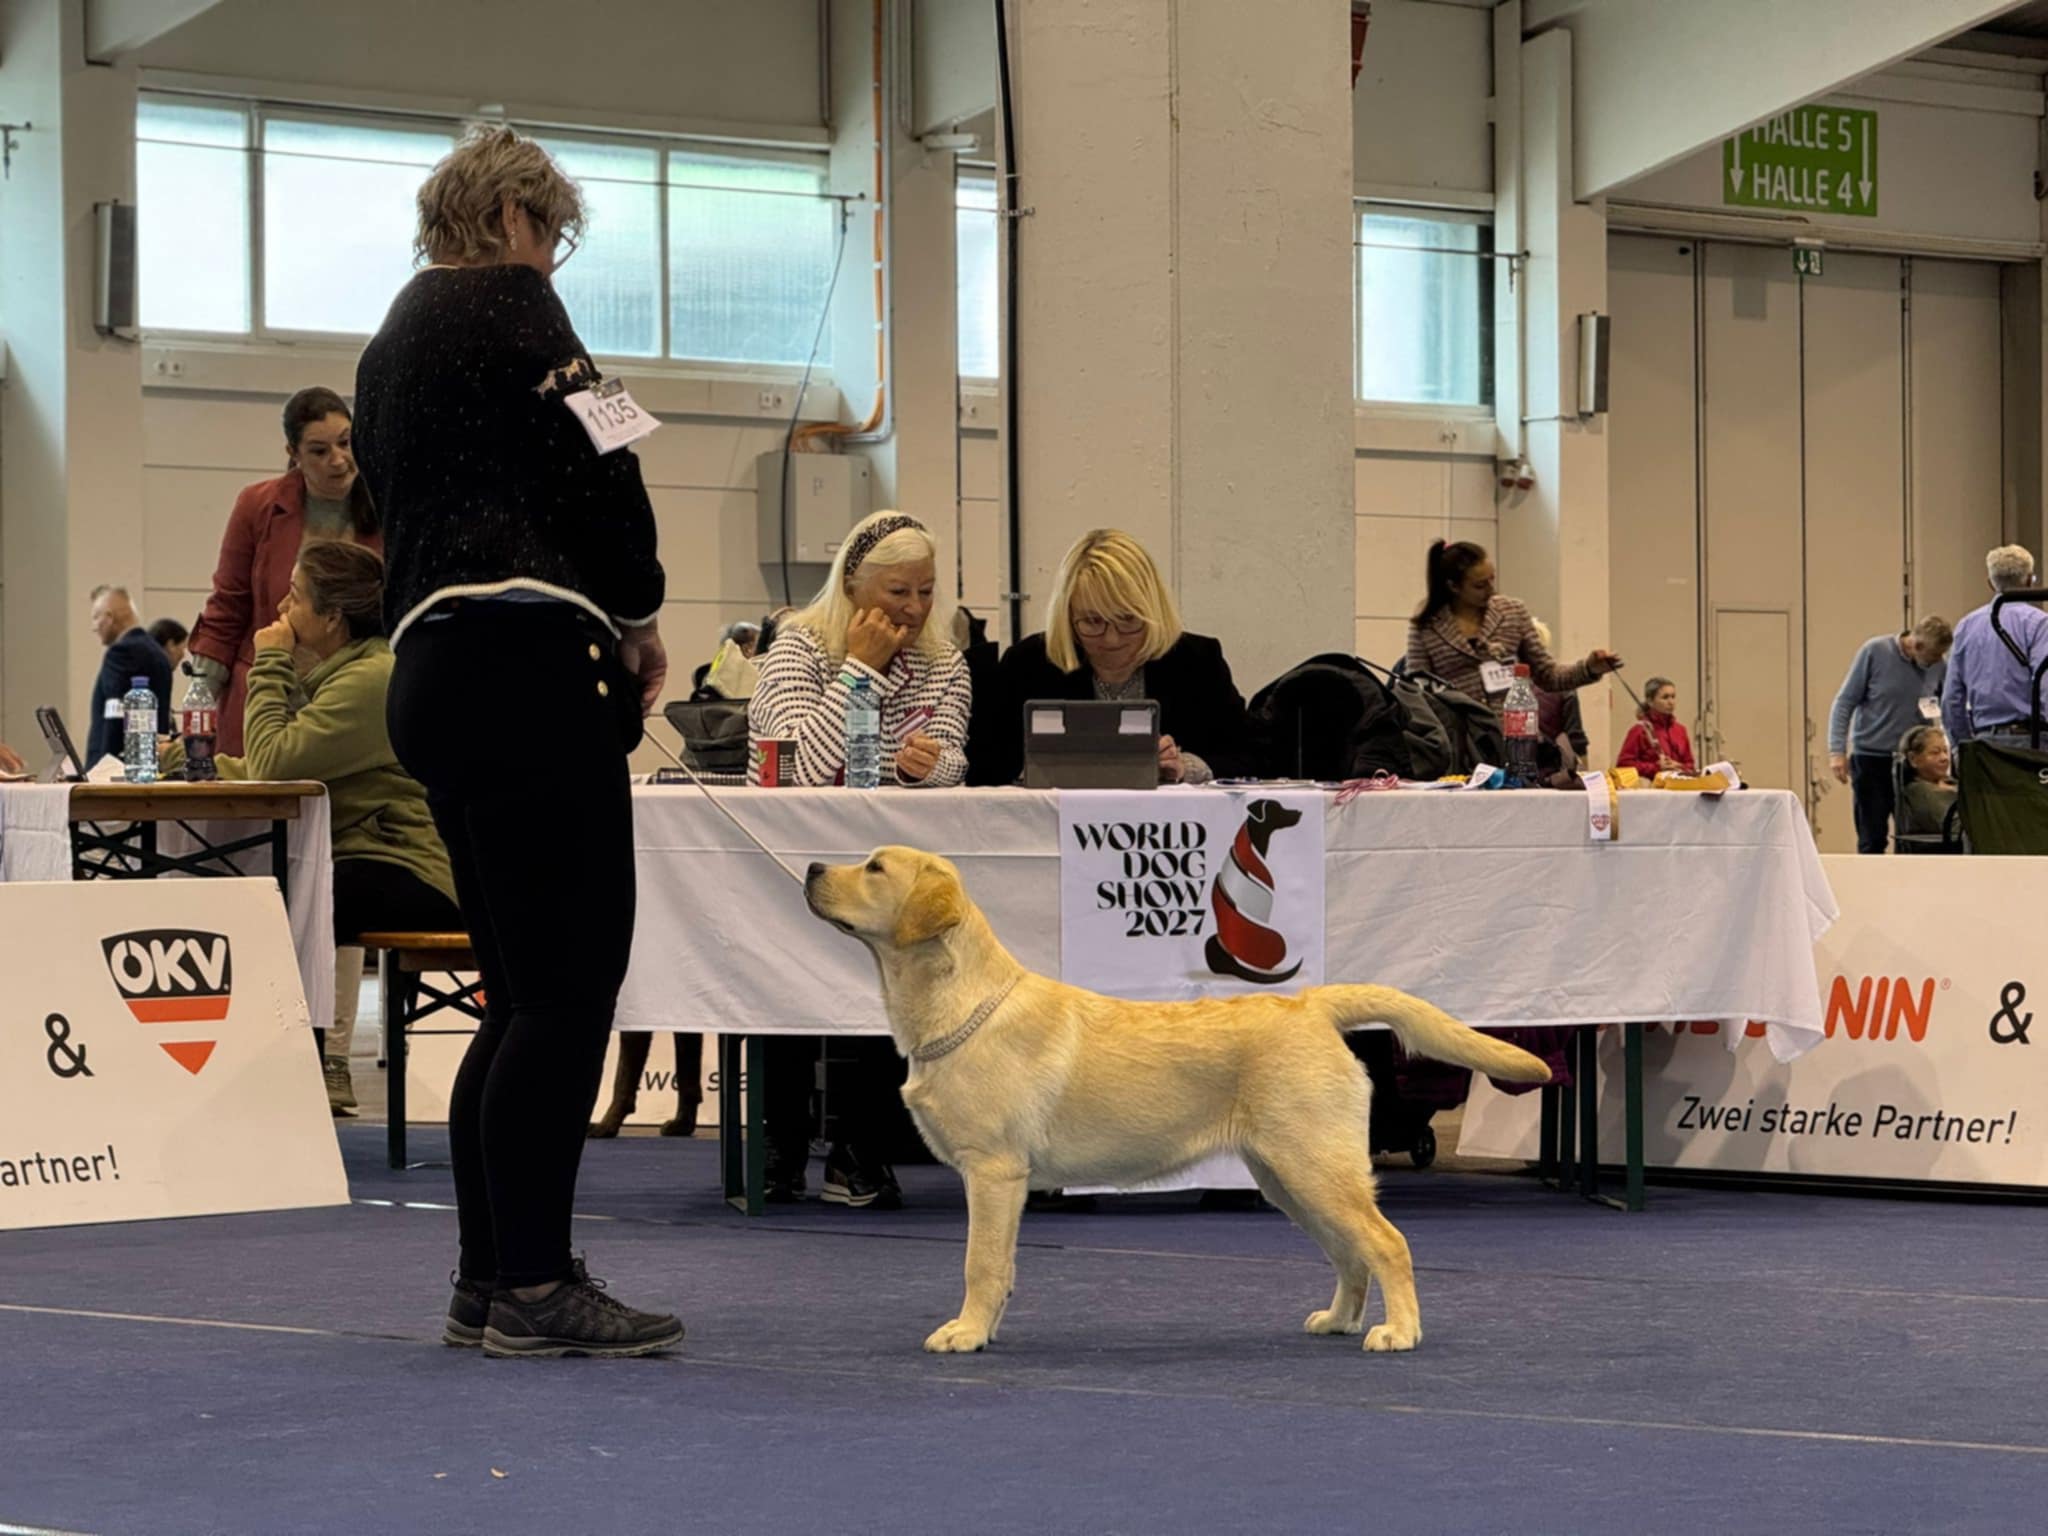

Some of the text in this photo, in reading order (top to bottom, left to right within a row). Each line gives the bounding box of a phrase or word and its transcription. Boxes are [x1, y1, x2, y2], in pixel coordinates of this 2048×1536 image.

[1837, 115, 1853, 152] 5
[1753, 163, 1853, 208] HALLE 4
[587, 397, 638, 431] 1135
[1072, 821, 1207, 851] WORLD
[1123, 850, 1206, 879] DOG
[1096, 879, 1206, 910] SHOW
[1125, 908, 1206, 937] 2027
[1988, 980, 2034, 1045] &
[44, 1012, 95, 1079] &
[1677, 1096, 2017, 1144] Zwei starke Partner!
